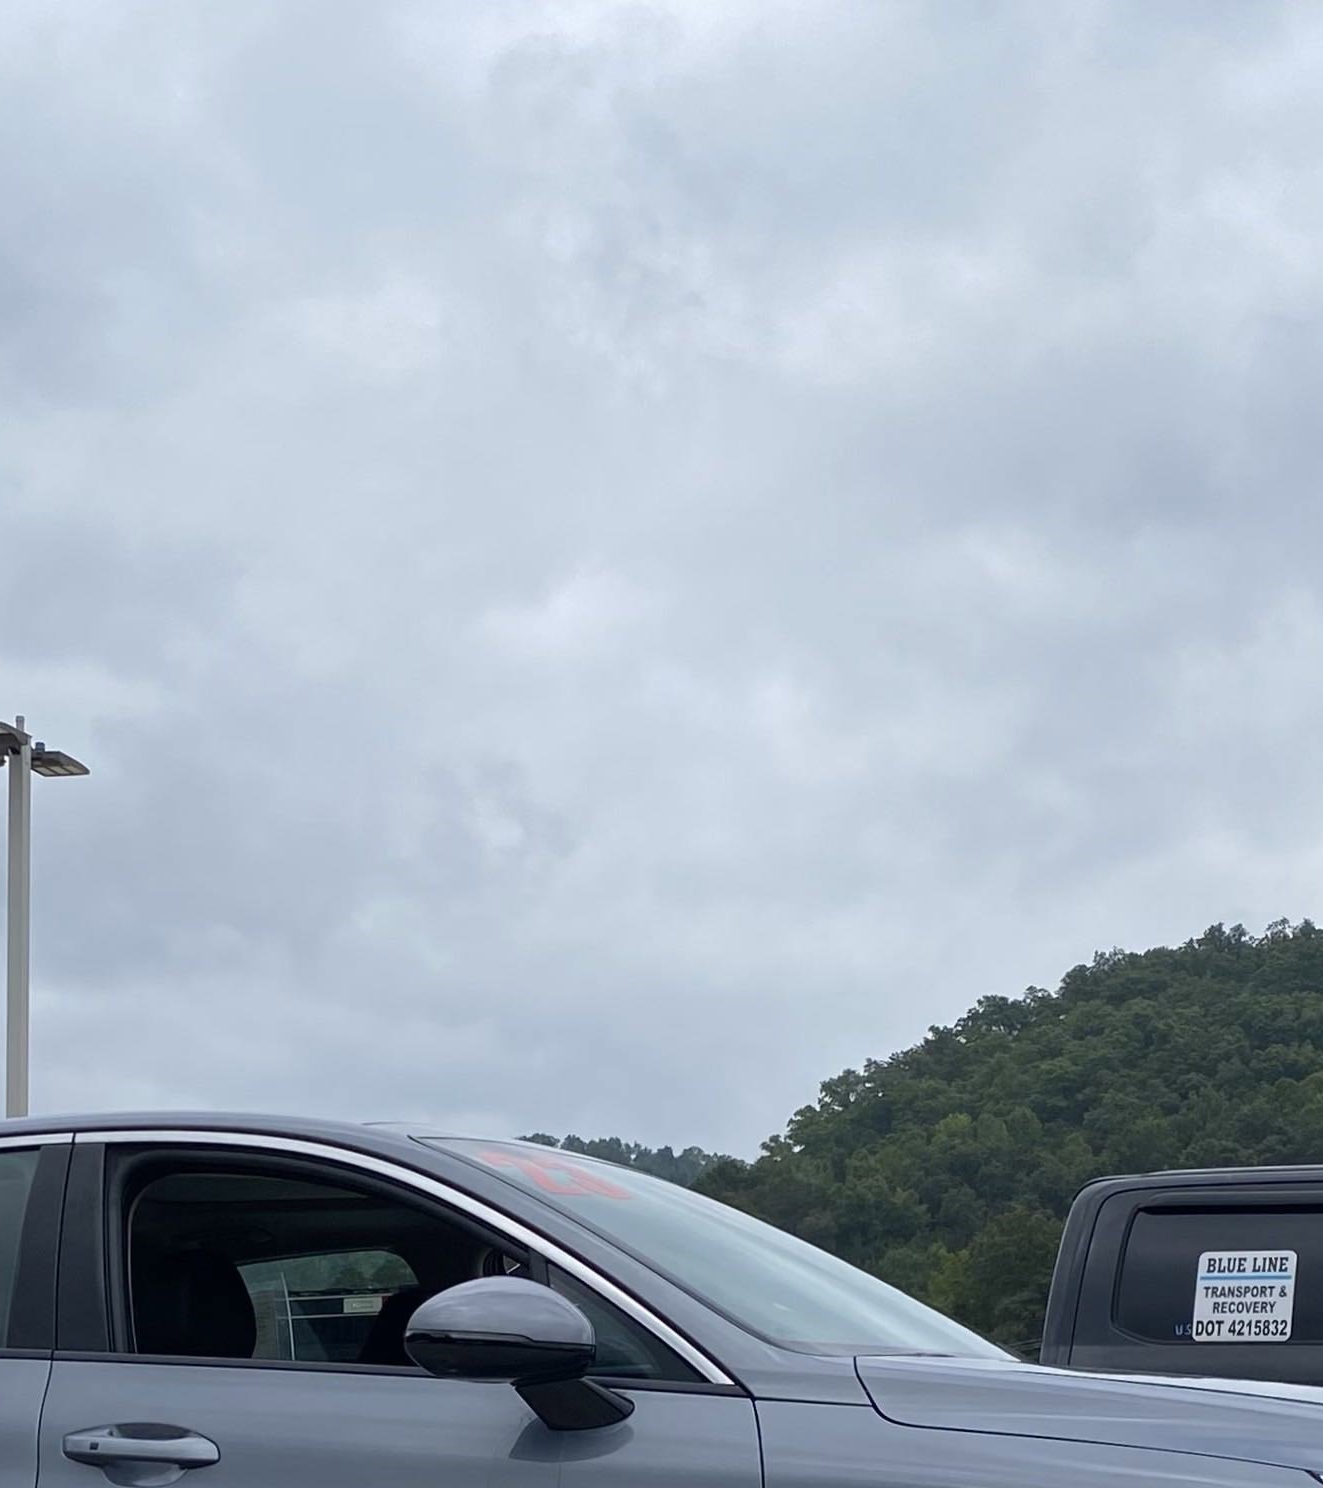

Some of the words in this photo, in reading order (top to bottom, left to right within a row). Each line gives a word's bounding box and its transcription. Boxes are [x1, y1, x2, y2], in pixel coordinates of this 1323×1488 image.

[1206, 1257, 1247, 1273] BLUE
[1252, 1256, 1289, 1272] LINE
[1204, 1286, 1275, 1298] TRANSPORT
[1279, 1285, 1287, 1297] &
[1212, 1301, 1276, 1314] RECOVERY
[1195, 1320, 1224, 1336] DOT
[1228, 1319, 1288, 1336] 4215832
